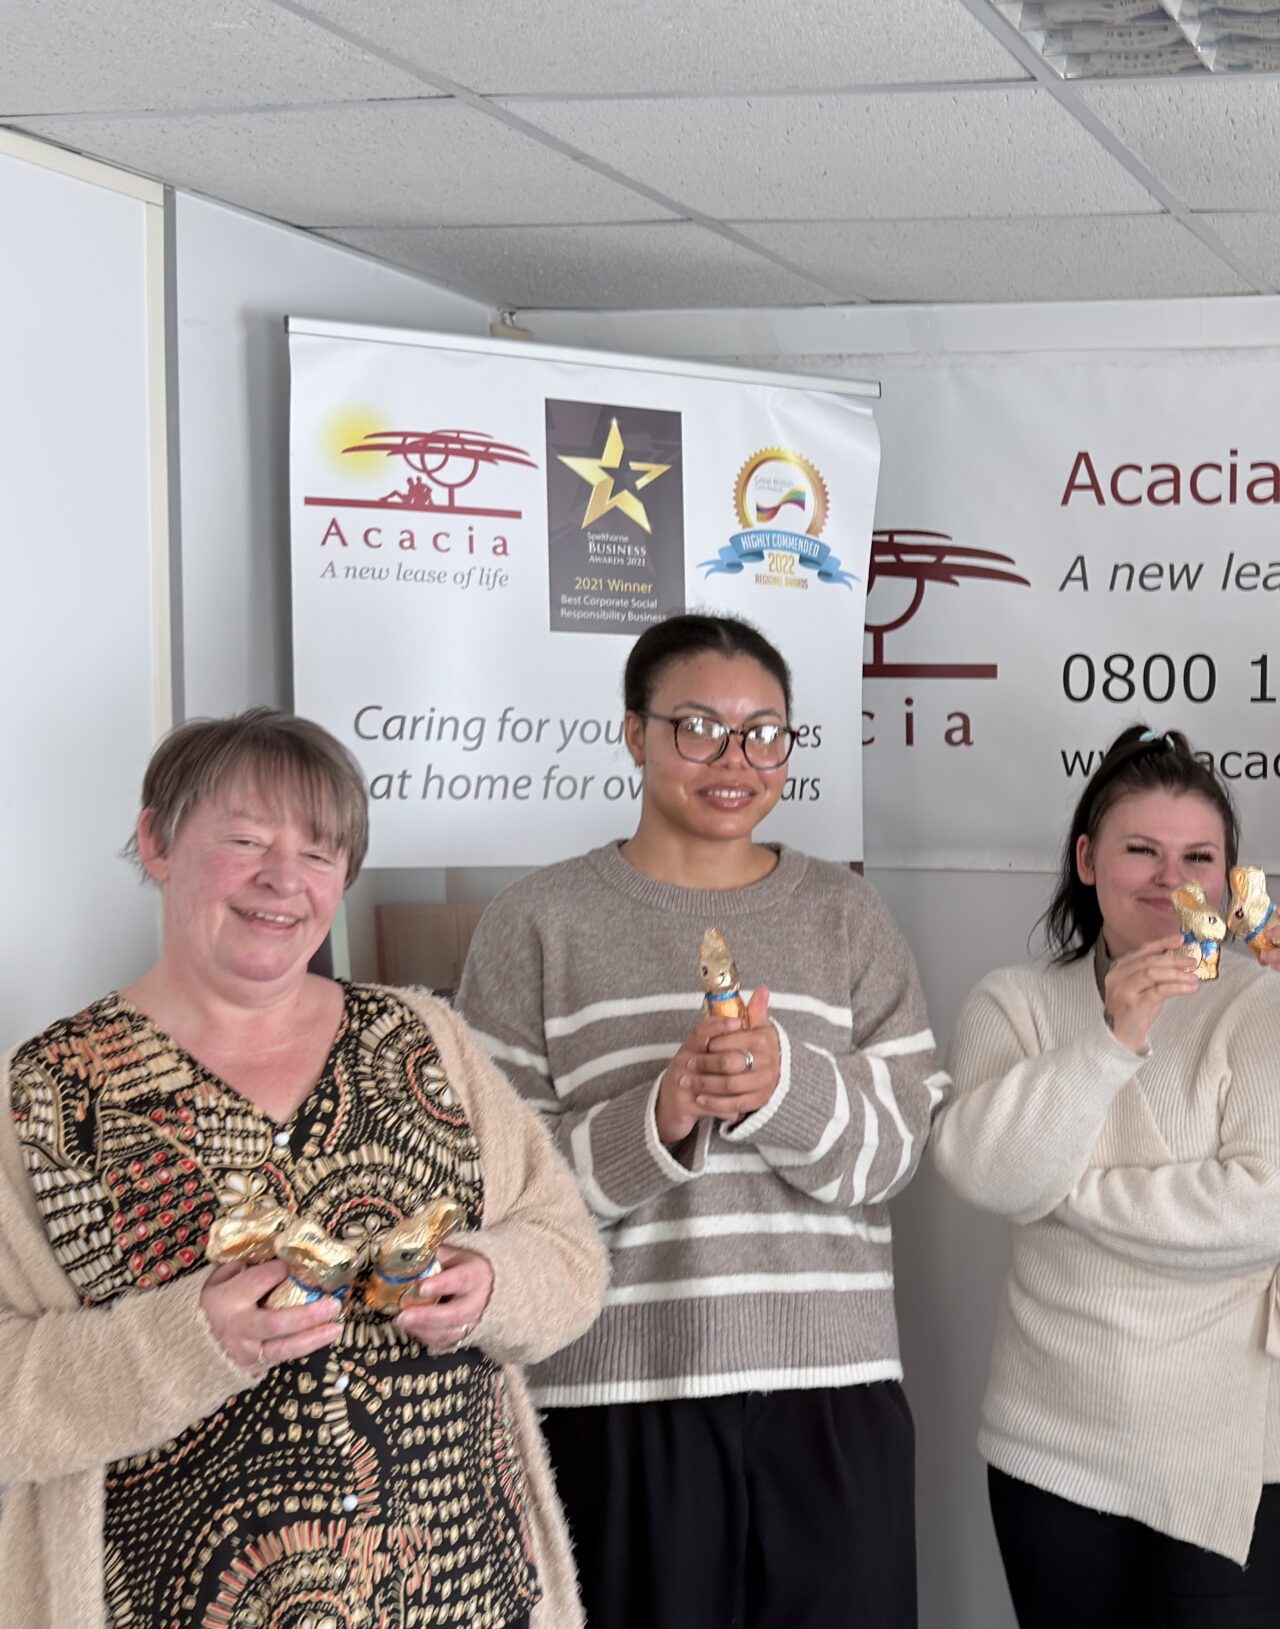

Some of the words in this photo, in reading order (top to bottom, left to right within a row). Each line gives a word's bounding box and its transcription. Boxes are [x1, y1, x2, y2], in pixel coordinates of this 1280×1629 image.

[320, 516, 510, 556] Acacia
[740, 533, 771, 551] HIGHLY
[771, 533, 820, 558] COMMENDED
[588, 541, 647, 557] BUSINESS
[626, 557, 646, 567] 2021
[767, 552, 796, 575] 2022
[1058, 554, 1090, 592] A
[1108, 561, 1204, 593] new
[320, 560, 337, 579] A
[345, 564, 389, 582] new
[396, 562, 447, 584] lease
[453, 566, 477, 589] of
[477, 566, 509, 591] life
[574, 577, 603, 591] 2021
[607, 578, 653, 594] Winner
[560, 593, 581, 605] Best
[583, 595, 630, 609] Corporate
[631, 597, 658, 609] Social
[560, 607, 626, 623] Responsibility
[627, 611, 667, 623] Business
[1062, 653, 1217, 704] 0800
[353, 704, 486, 752] Caring
[497, 706, 550, 744] for
[556, 717, 625, 754] you
[369, 768, 412, 801] at
[421, 763, 532, 801] home
[542, 765, 595, 801] for
[602, 775, 644, 801] ov
[780, 776, 821, 802] ars
